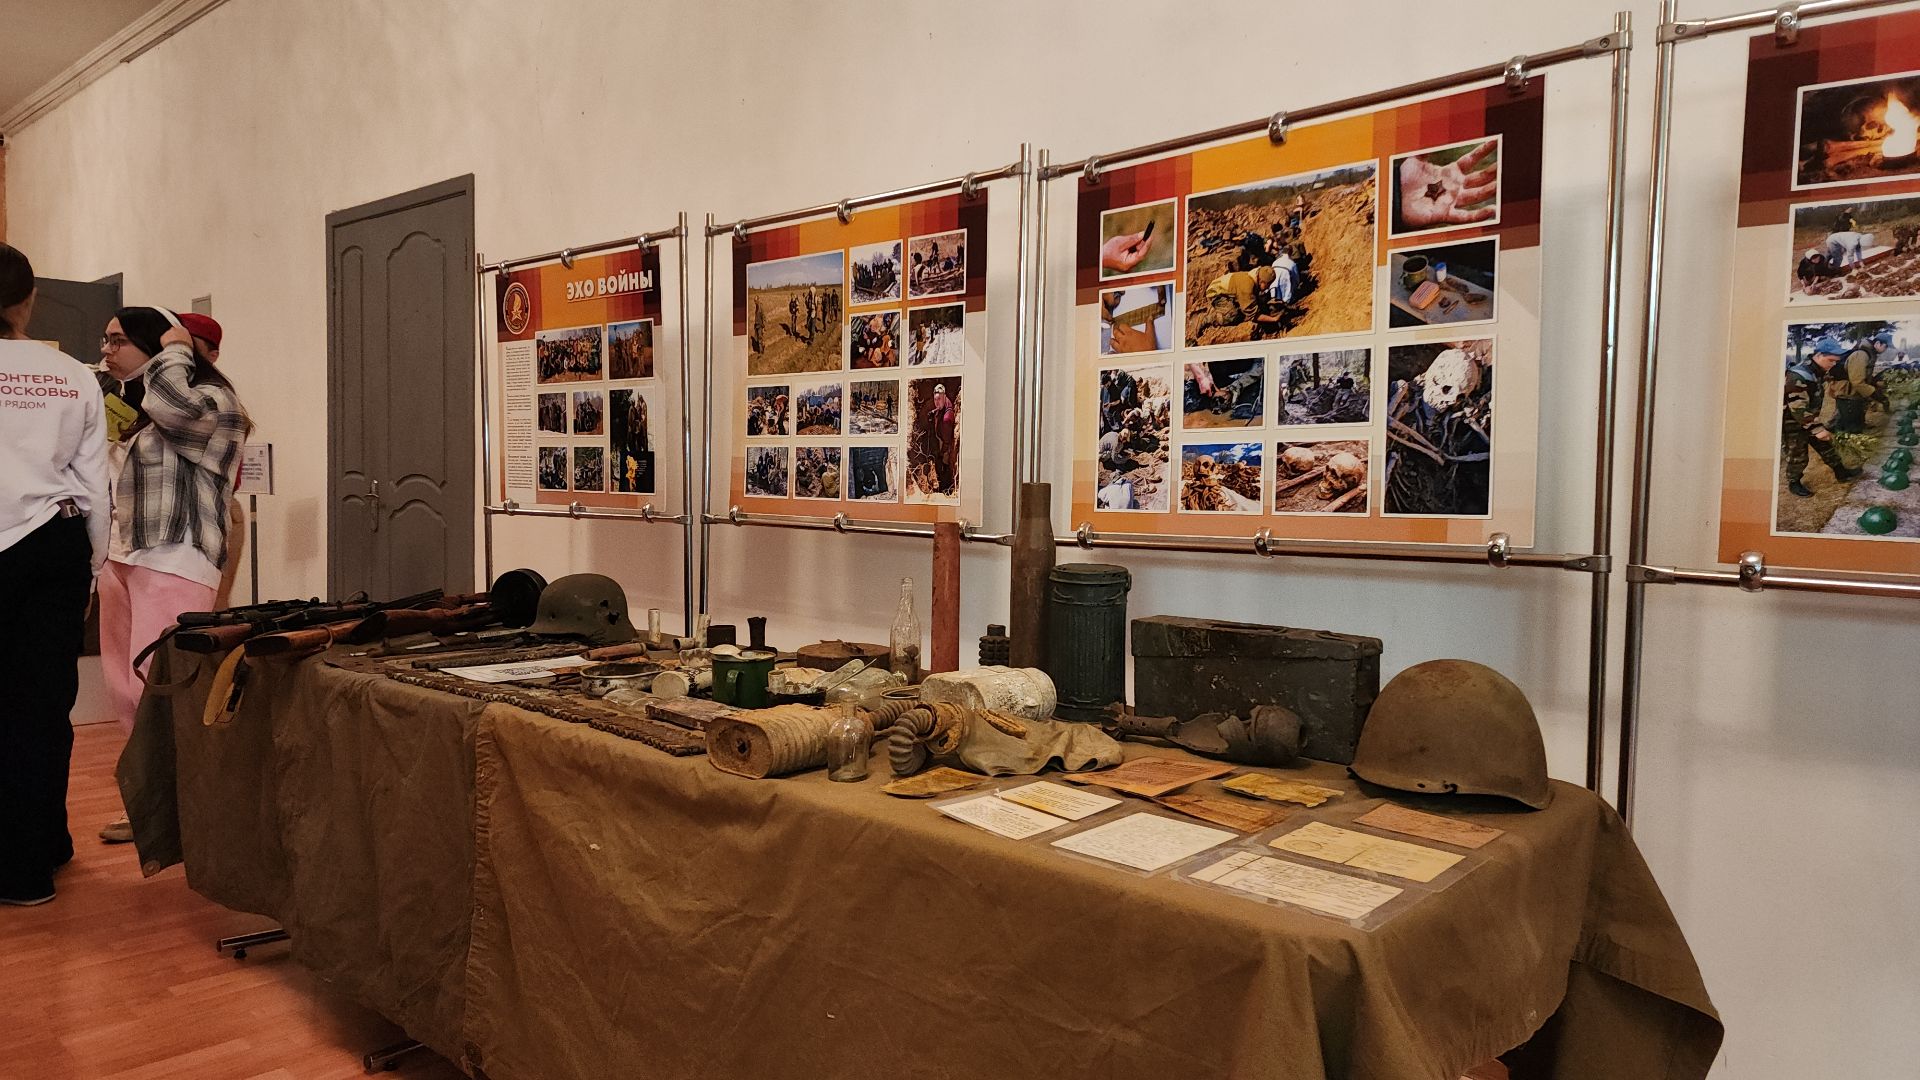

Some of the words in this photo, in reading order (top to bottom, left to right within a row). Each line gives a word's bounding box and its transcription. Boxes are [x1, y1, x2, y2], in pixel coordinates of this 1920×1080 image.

[566, 279, 595, 300] ЭХО
[597, 269, 653, 295] ВОЙНЫ
[0, 385, 79, 399] ОСКОВЬЯ
[5, 400, 46, 409] РЯДОМ
